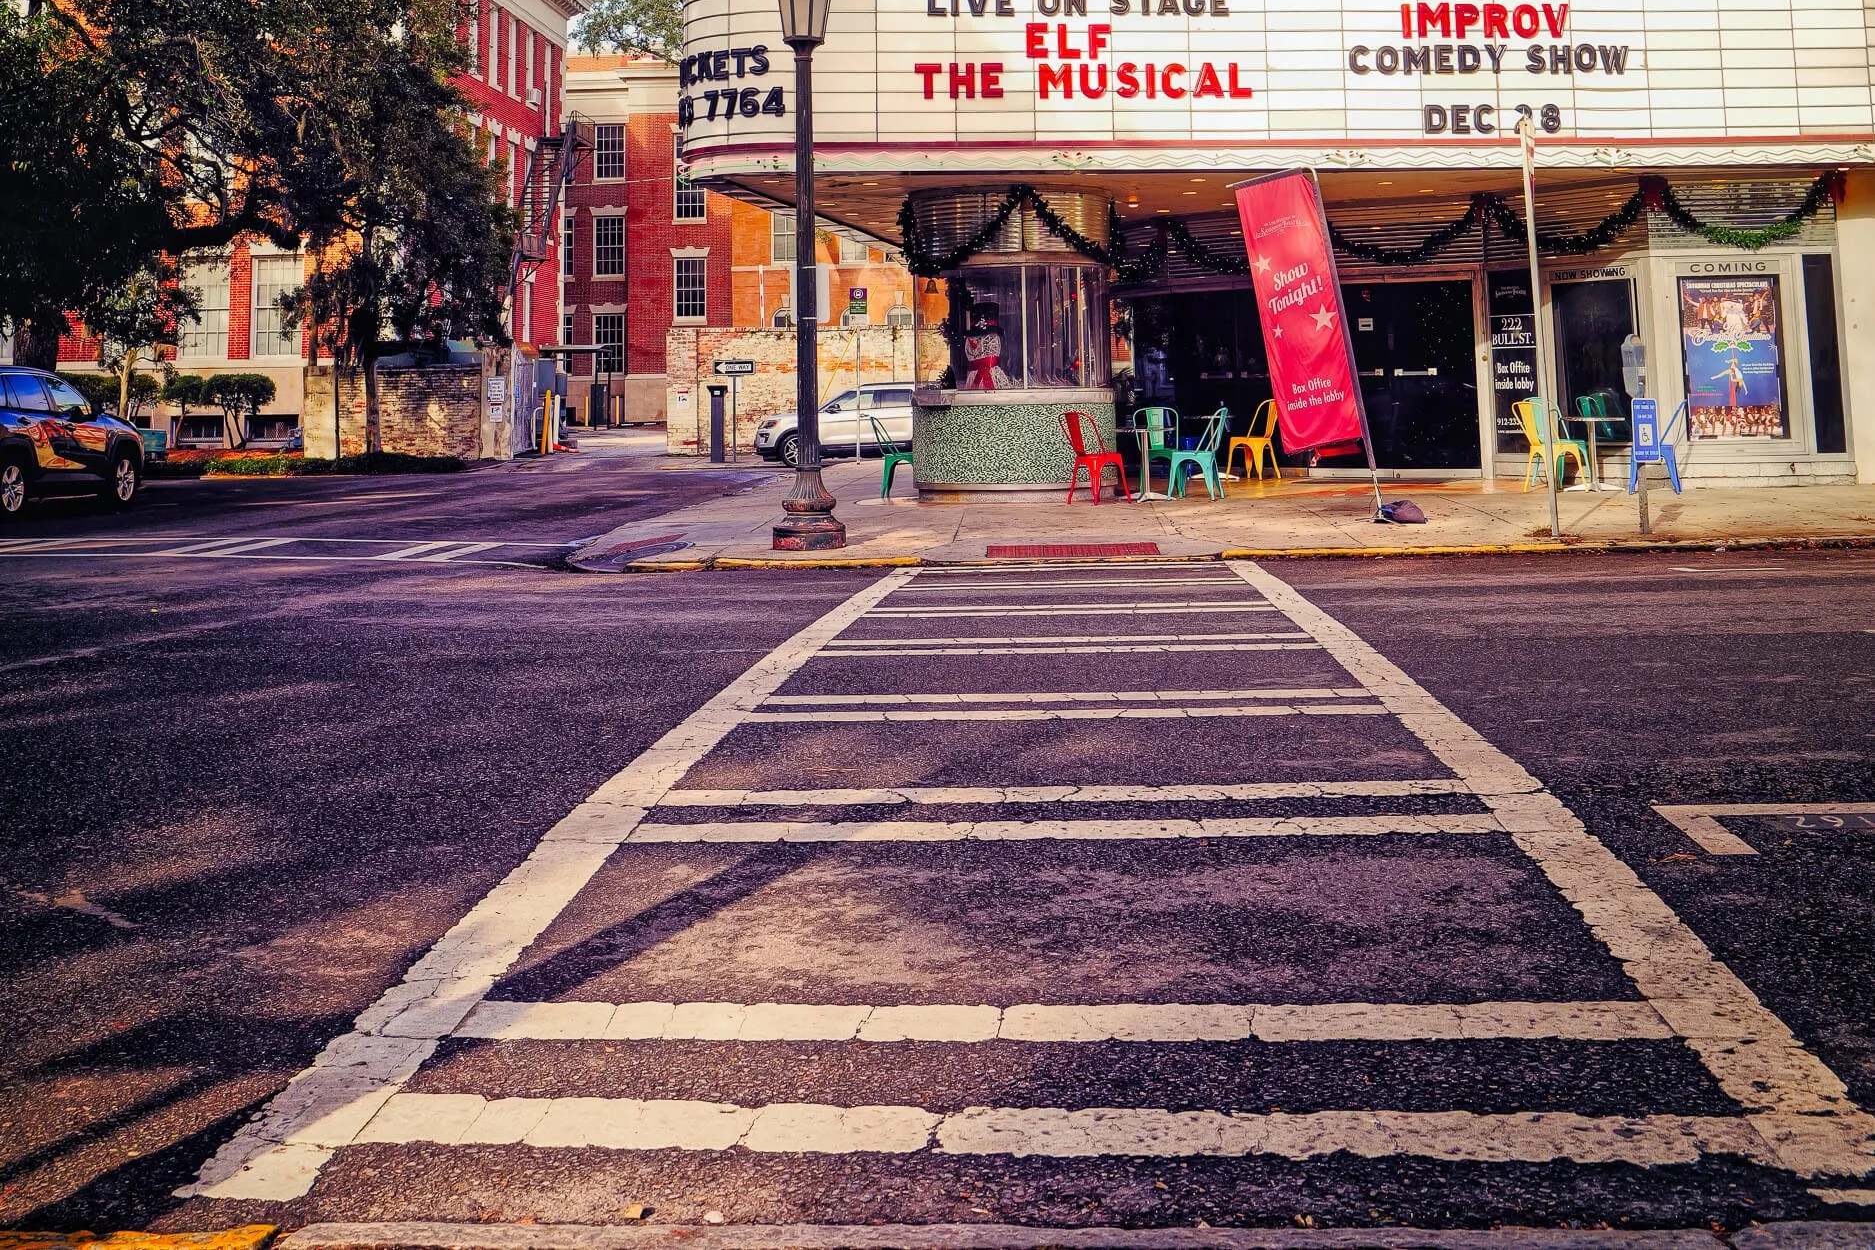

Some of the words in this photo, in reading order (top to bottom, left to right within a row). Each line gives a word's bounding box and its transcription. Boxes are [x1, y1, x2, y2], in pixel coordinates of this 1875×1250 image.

[1400, 2, 1568, 39] IMPROV
[1026, 23, 1112, 59] ELF
[1349, 44, 1508, 75] COMEDY
[1525, 43, 1629, 74] SHOW
[914, 63, 1003, 99] THE
[1039, 62, 1253, 99] MUSICAL
[704, 87, 785, 121] 7764
[1424, 104, 1495, 134] DEC
[1273, 262, 1308, 291] Show
[1555, 272, 1577, 280] NOW
[1581, 267, 1626, 278] SHOWING
[1690, 262, 1767, 273] COMING
[1268, 275, 1323, 315] Tonight!
[1501, 317, 1522, 330] 222
[1492, 333, 1518, 345] BULL
[1519, 332, 1535, 345] ST.
[725, 363, 737, 371] ONE
[1497, 362, 1508, 374] Box
[1509, 361, 1530, 374] Office
[1292, 383, 1307, 395] Box
[1307, 377, 1332, 391] Office
[1495, 377, 1514, 390] inside
[1514, 376, 1534, 392] lobby
[1286, 397, 1308, 411] inside
[1308, 395, 1323, 406] the
[1323, 389, 1345, 403] lobby
[1496, 418, 1521, 426] 912-23
